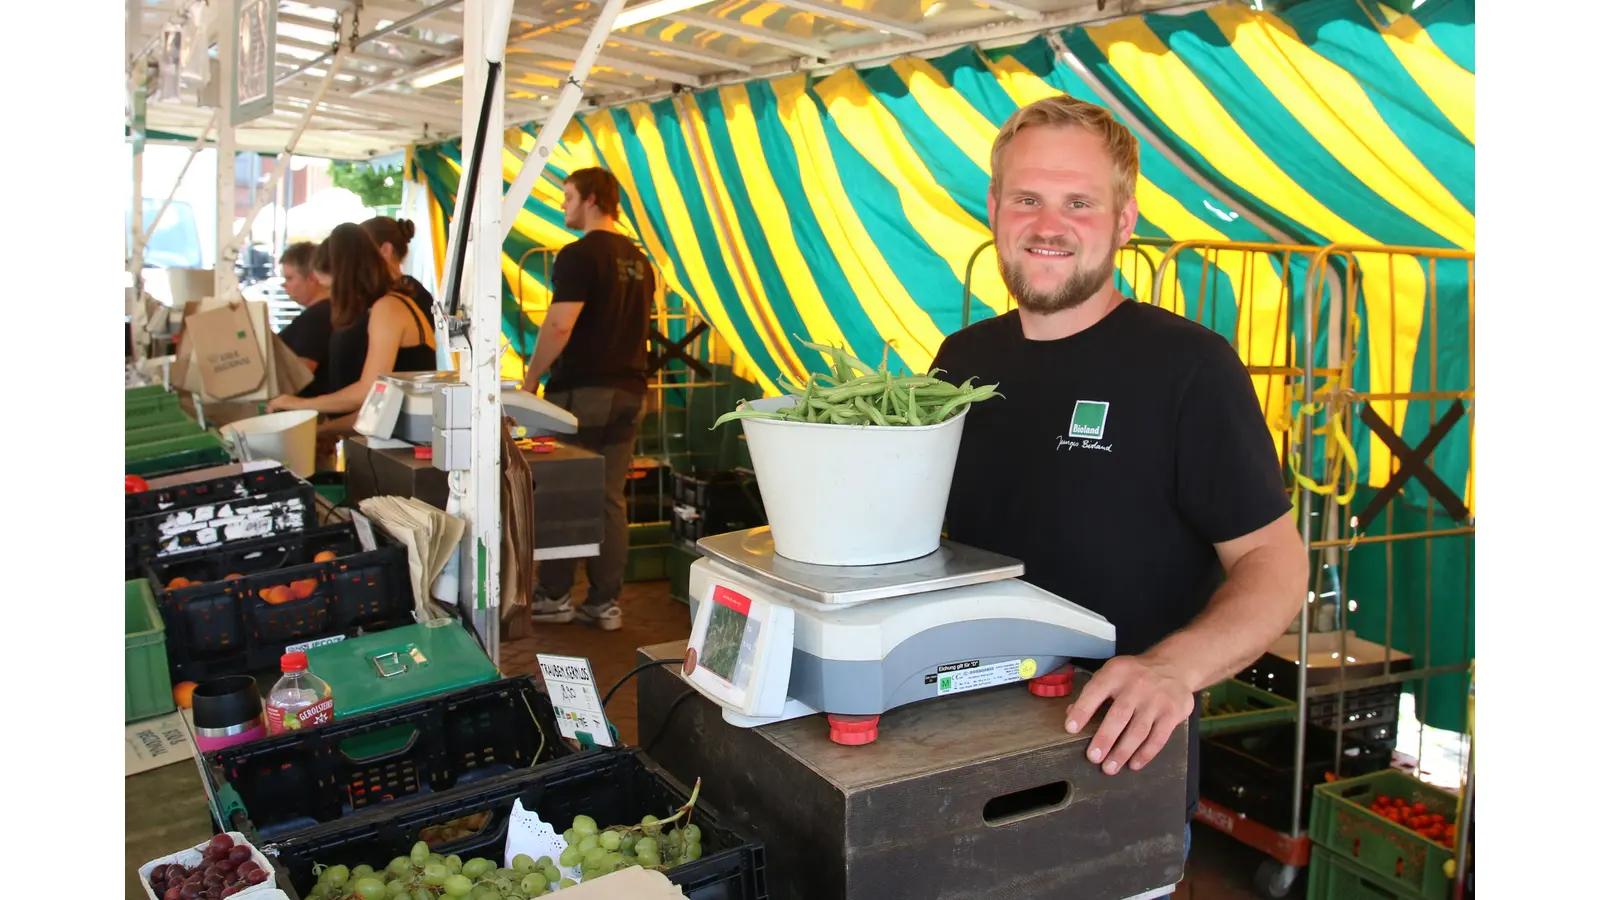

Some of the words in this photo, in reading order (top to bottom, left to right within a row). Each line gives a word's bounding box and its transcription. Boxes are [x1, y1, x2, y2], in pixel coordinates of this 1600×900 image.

[1073, 423, 1101, 434] Bioland
[1081, 440, 1113, 453] Bioland
[540, 663, 567, 679] TRAUBEN
[565, 665, 590, 681] KERNLOS
[942, 679, 950, 688] M
